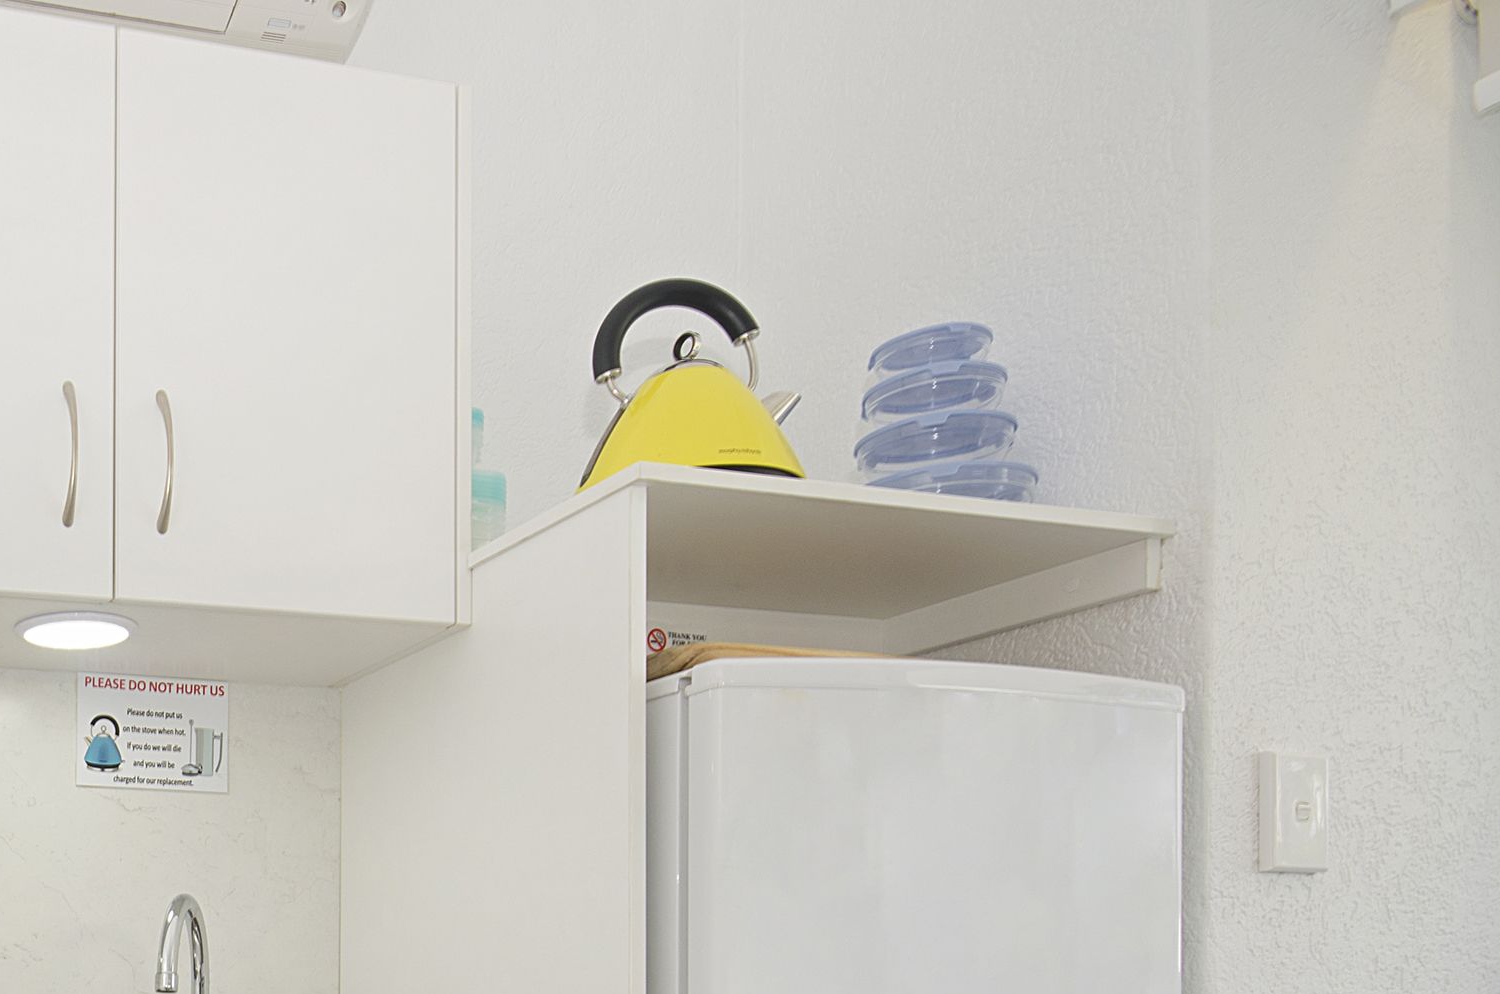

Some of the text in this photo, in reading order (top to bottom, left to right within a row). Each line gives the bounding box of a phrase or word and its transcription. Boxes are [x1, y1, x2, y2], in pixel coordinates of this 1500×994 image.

[668, 631, 691, 640] THANK
[84, 676, 224, 696] PLEASE DO NOT HURT US
[127, 708, 145, 717] Please
[146, 710, 153, 718] do
[113, 776, 135, 784] charged
[157, 778, 194, 786] replacement.
